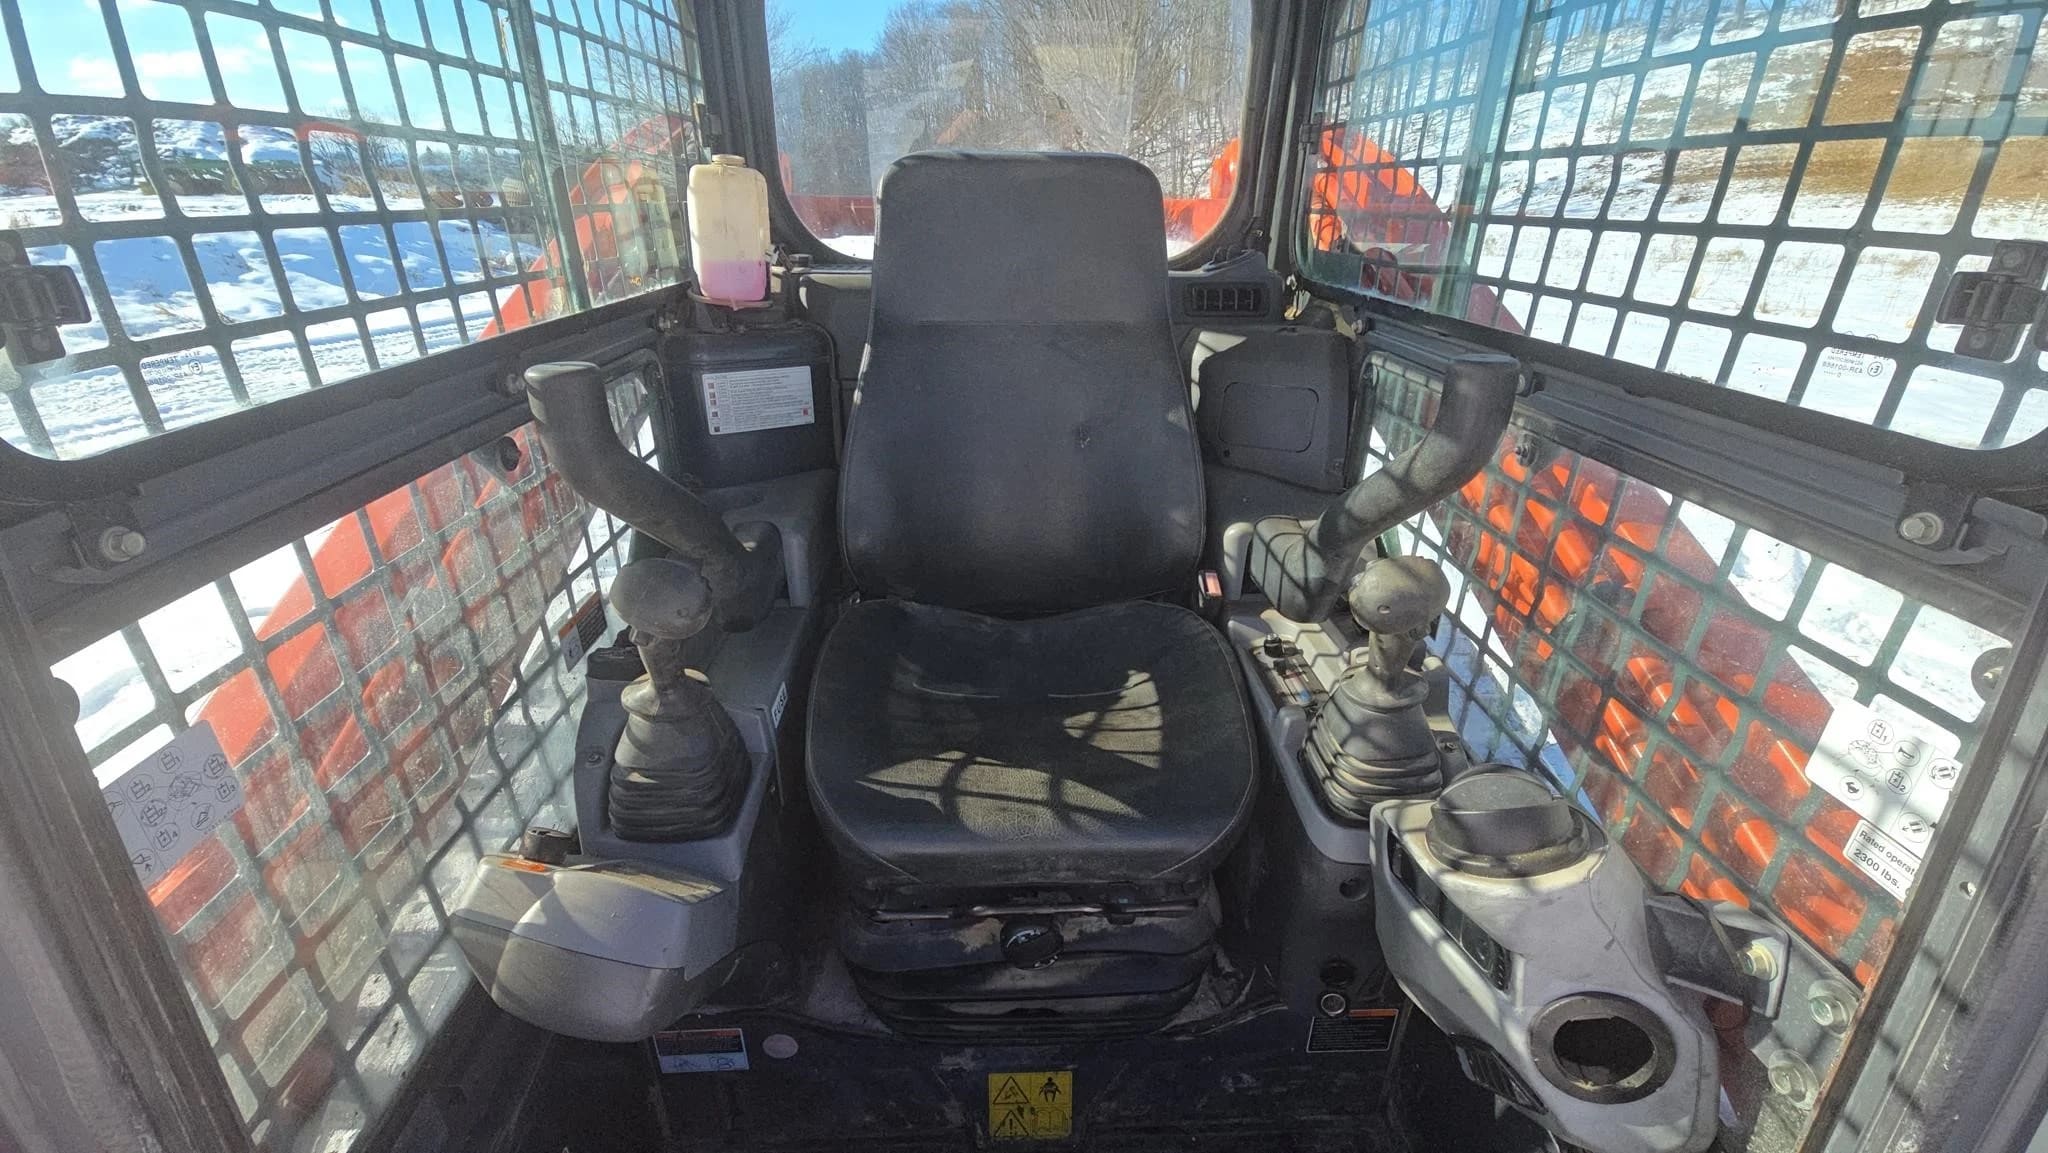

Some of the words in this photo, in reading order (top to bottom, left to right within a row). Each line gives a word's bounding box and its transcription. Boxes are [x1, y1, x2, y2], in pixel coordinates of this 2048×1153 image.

[774, 688, 787, 721] FUSE
[1860, 830, 1885, 853] Rated
[1854, 848, 1880, 871] 2300
[1881, 868, 1900, 889] lbs.
